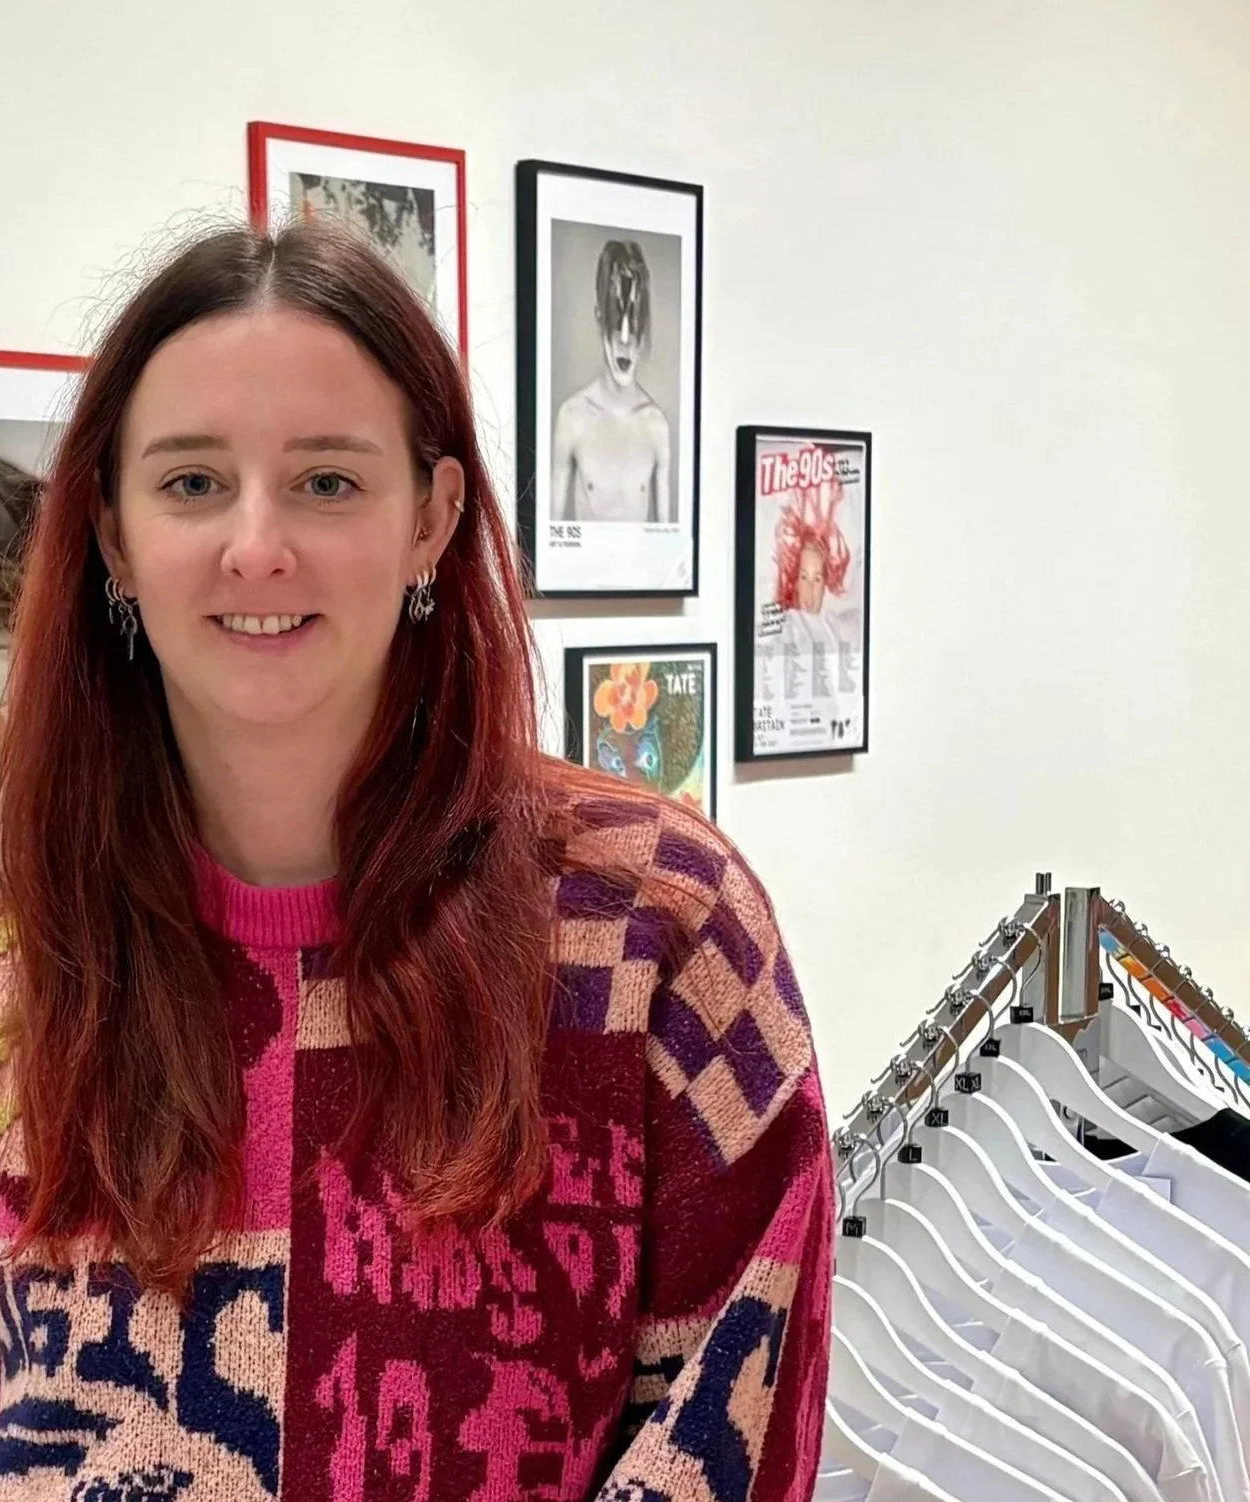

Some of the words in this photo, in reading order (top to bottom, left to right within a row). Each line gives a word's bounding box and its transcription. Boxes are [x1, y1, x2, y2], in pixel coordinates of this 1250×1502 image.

[664, 673, 697, 695] TATE
[931, 1111, 948, 1126] XL
[909, 1148, 919, 1161] L
[845, 1221, 858, 1236] M
